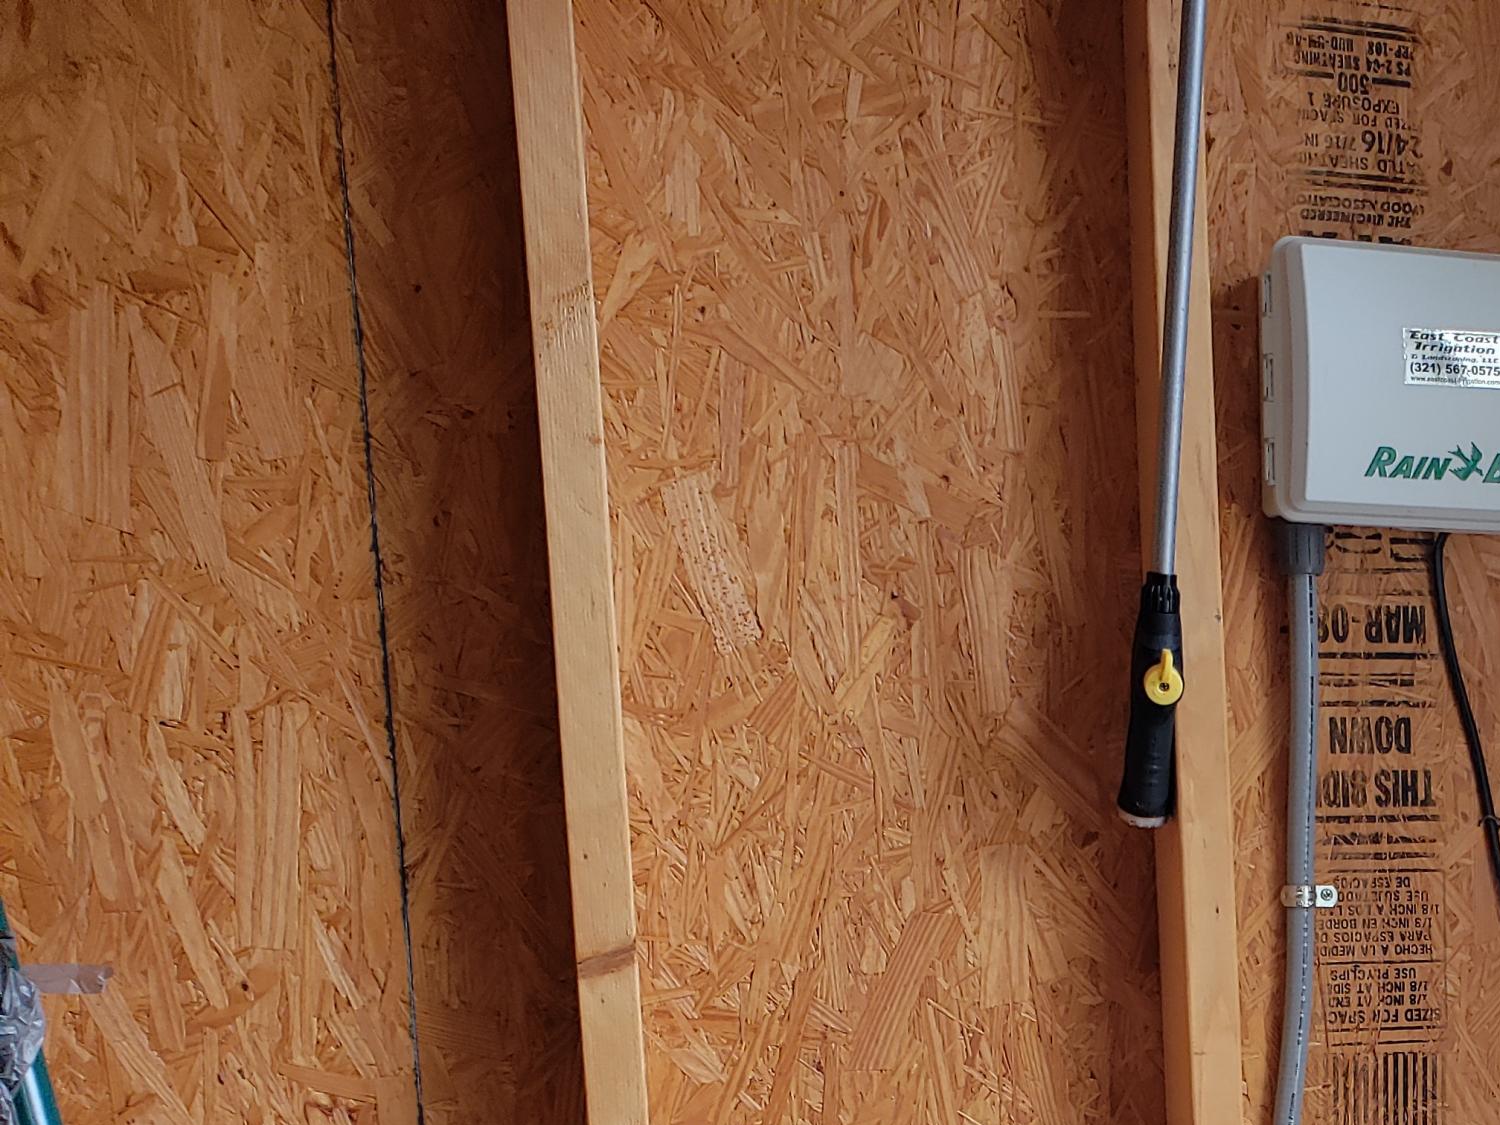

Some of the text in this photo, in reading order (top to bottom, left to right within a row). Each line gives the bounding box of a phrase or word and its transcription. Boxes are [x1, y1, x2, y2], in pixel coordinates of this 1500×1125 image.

[1337, 71, 1370, 95] 500
[1360, 130, 1424, 159] 24/16
[1409, 330, 1499, 344] East Coast
[1414, 341, 1495, 354] Irrigation
[1410, 362, 1500, 376] (321) 567-0575
[1365, 445, 1454, 481] RAIN
[1328, 716, 1412, 755] DOWN
[1374, 769, 1437, 808] THIS
[1395, 876, 1411, 888] DE
[1389, 903, 1417, 916] INCH
[1318, 918, 1357, 930] BORDE
[1361, 918, 1377, 930] EN
[1333, 931, 1395, 943] ESPACIOS
[1400, 930, 1432, 942] PARA
[1319, 943, 1433, 958] HECHO A LA MEDID
[1394, 967, 1417, 979] USE
[1377, 980, 1405, 993] INCH
[1377, 994, 1405, 1007] INCH
[1328, 1010, 1366, 1024] SPAC
